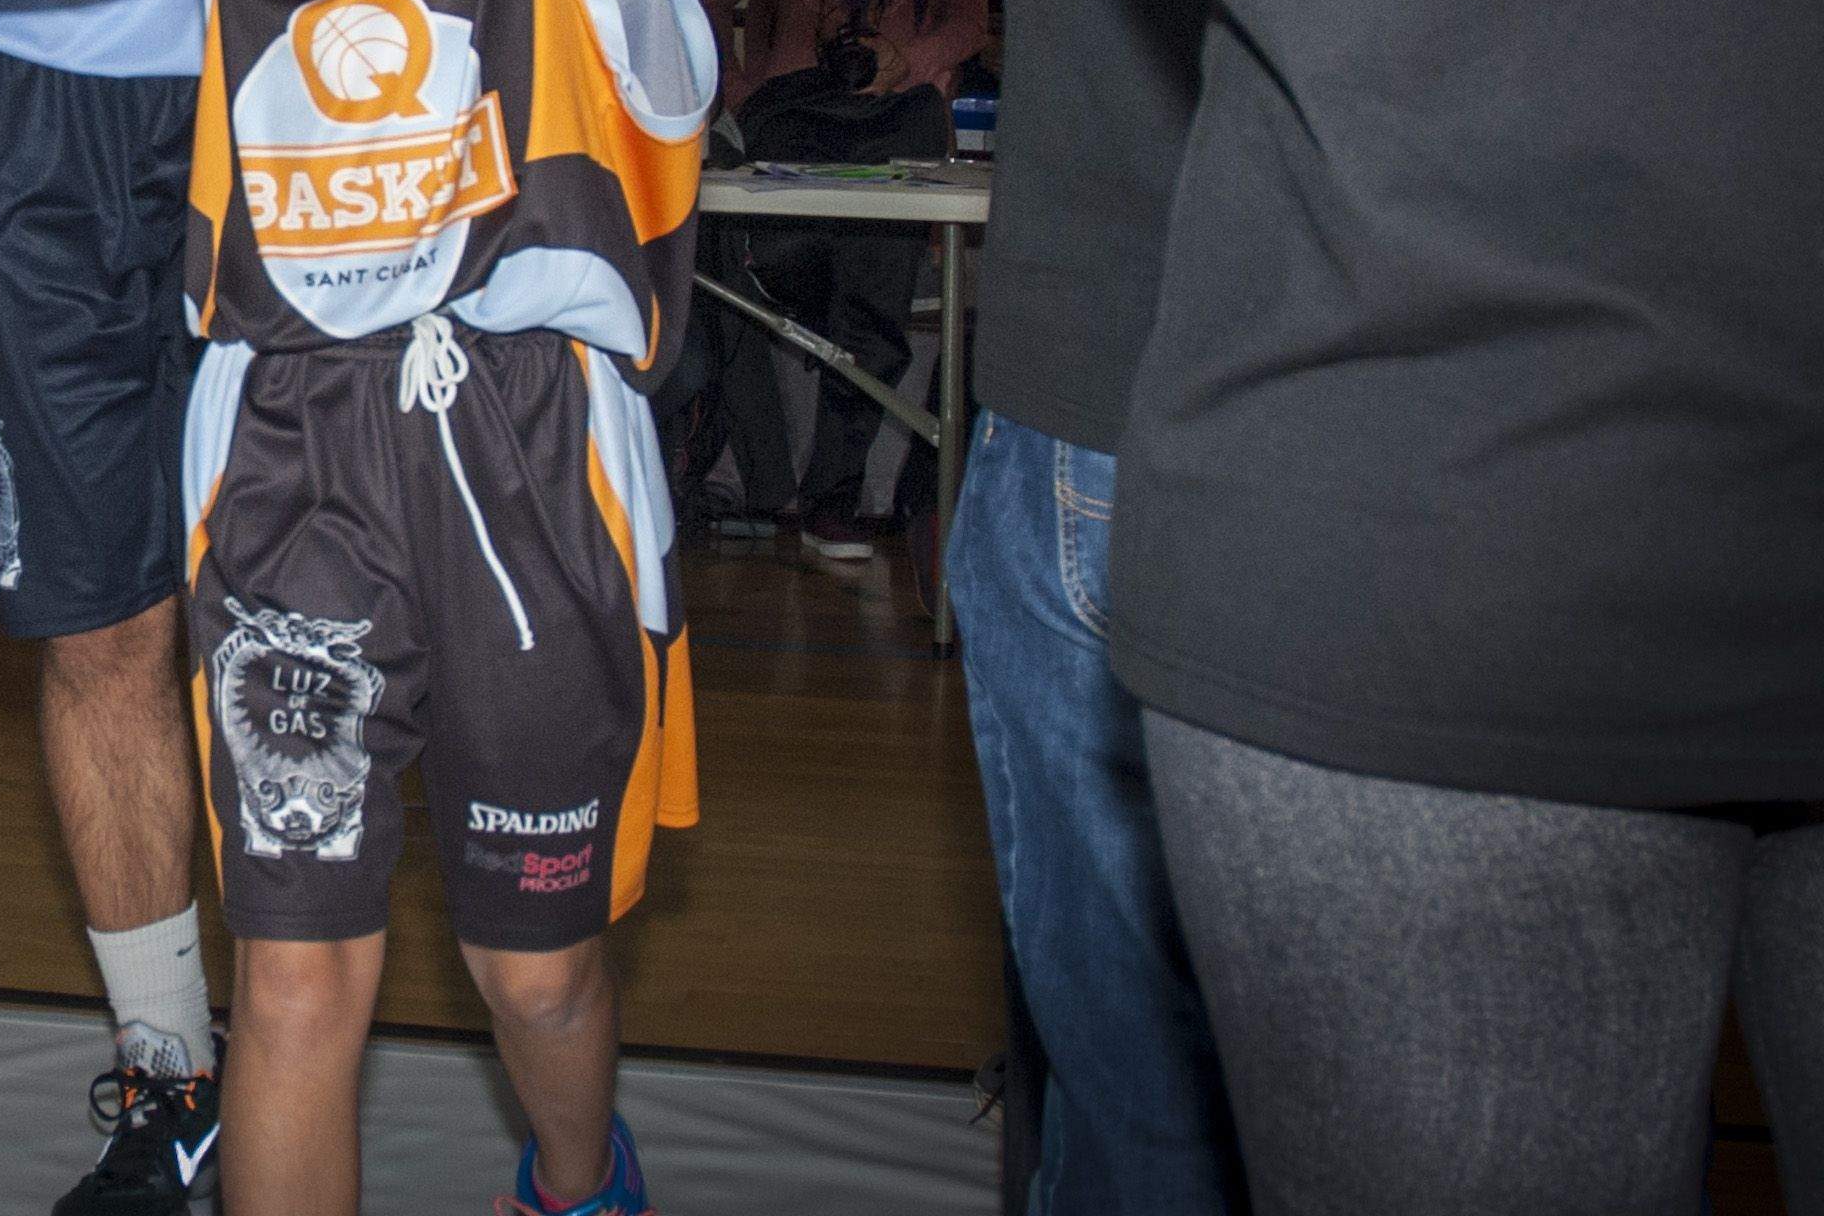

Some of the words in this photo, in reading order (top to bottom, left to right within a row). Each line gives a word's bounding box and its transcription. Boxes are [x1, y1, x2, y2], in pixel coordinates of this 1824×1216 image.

[304, 268, 370, 288] SANT
[272, 665, 332, 698] LUZ
[269, 709, 327, 739] GAS
[468, 797, 600, 835] SPALDING
